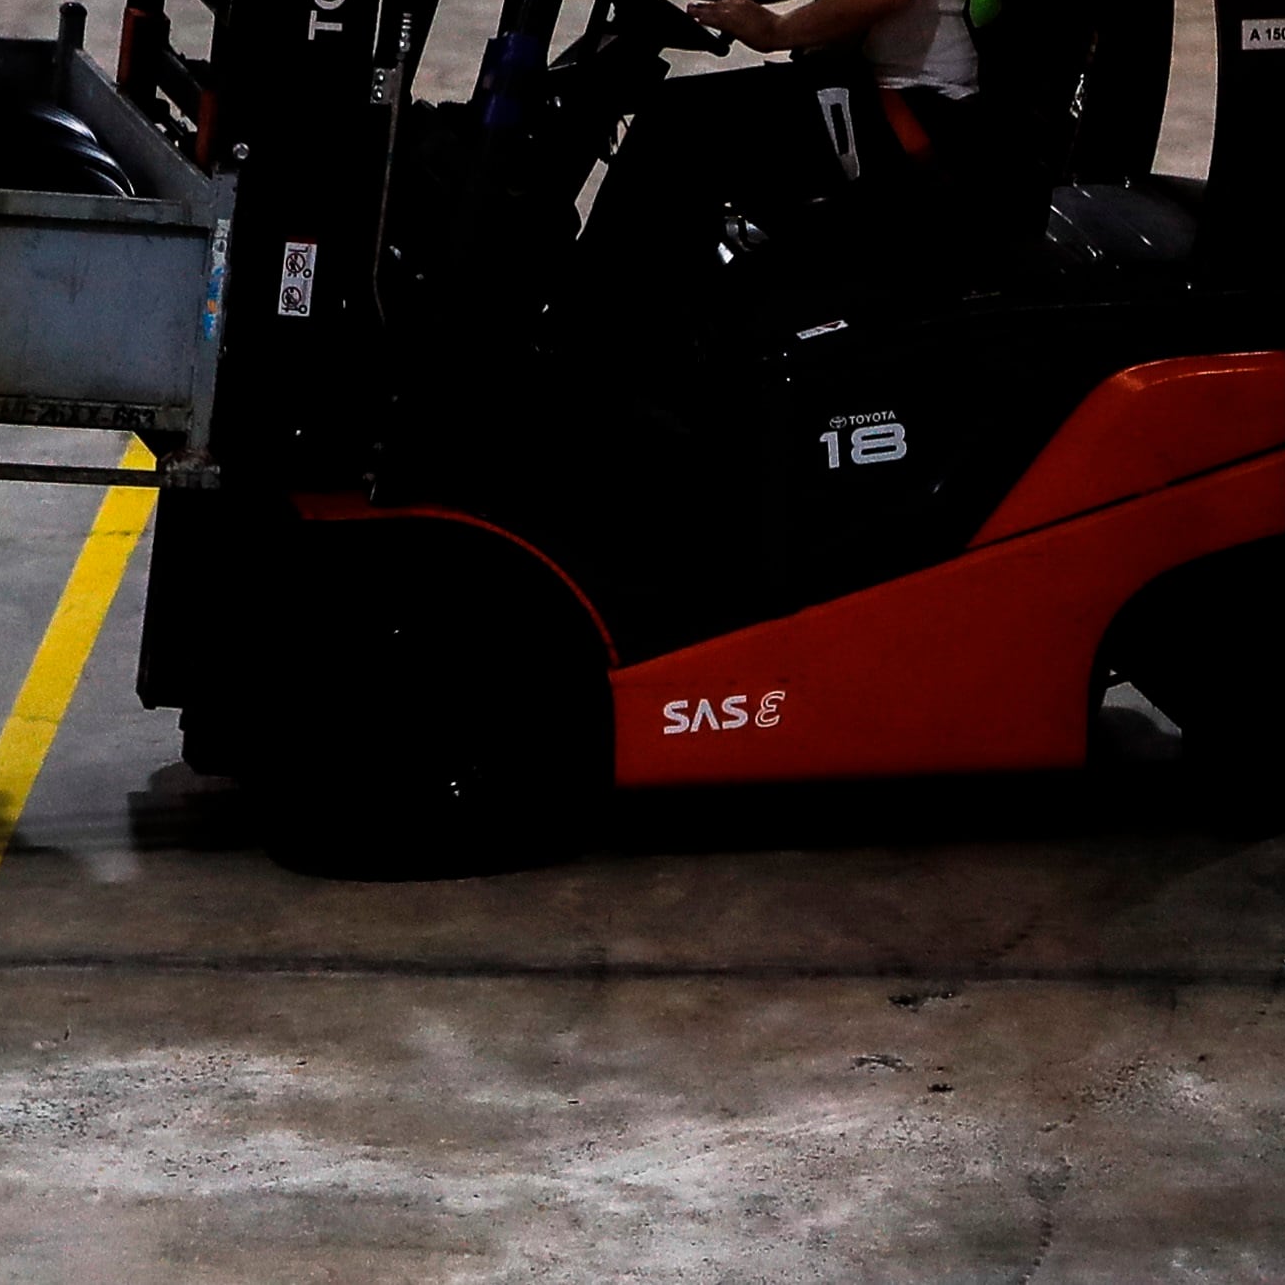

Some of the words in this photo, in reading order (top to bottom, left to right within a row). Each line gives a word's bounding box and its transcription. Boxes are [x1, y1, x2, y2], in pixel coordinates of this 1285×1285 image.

[1250, 28, 1260, 41] A
[848, 410, 897, 425] TOYOTA
[819, 423, 908, 469] 18
